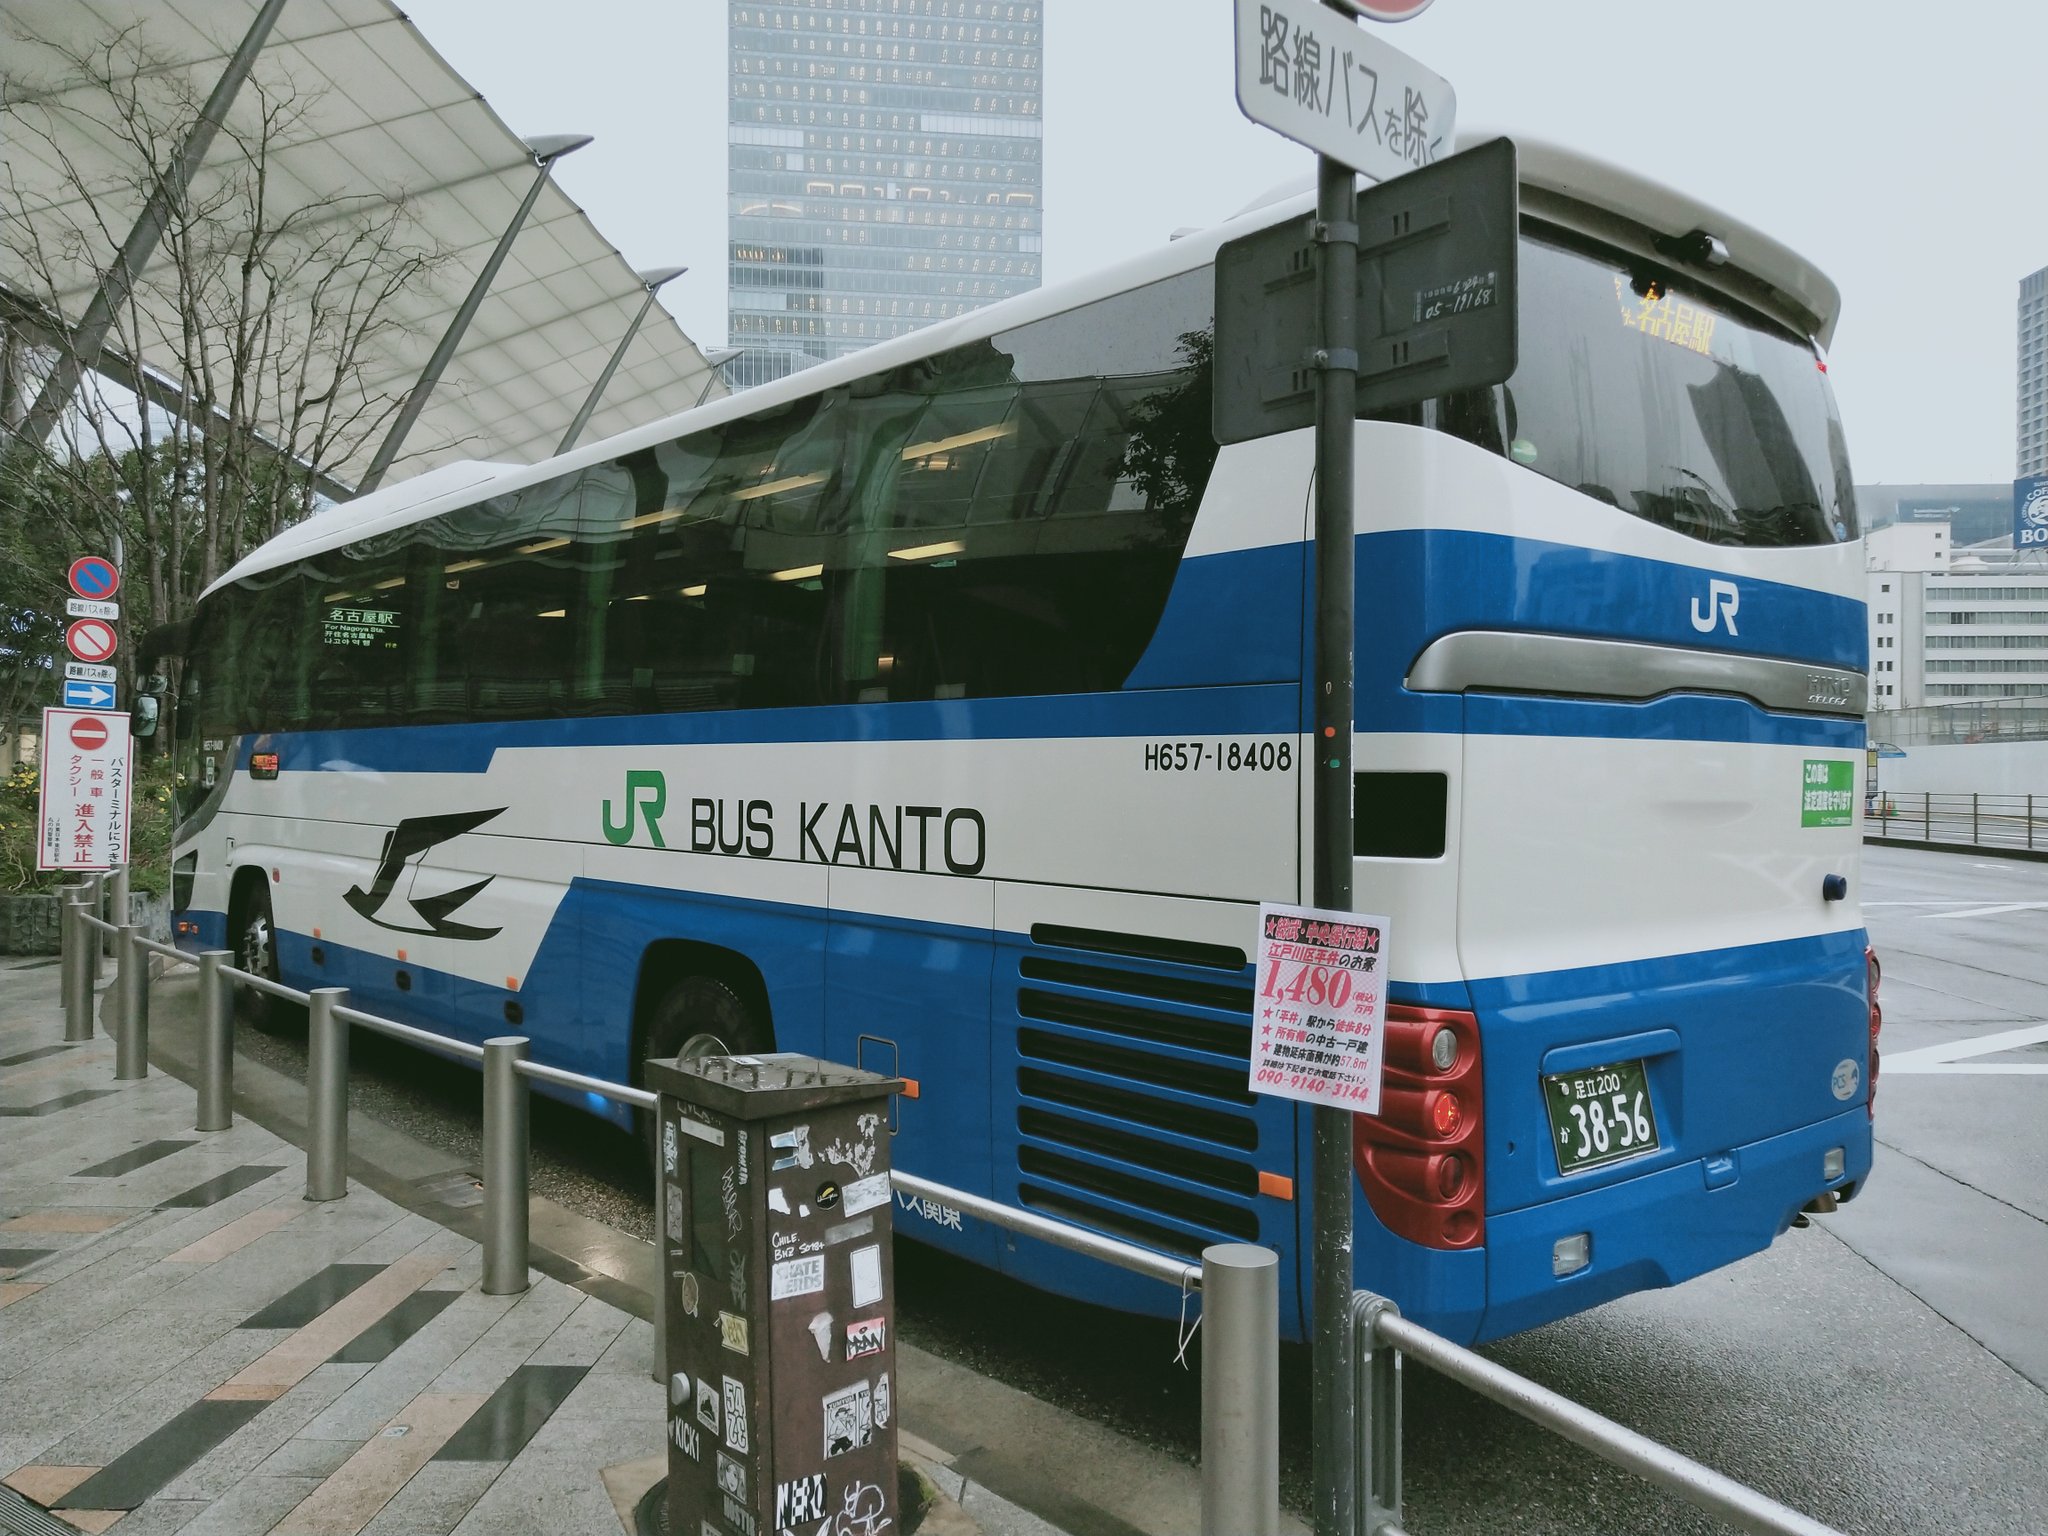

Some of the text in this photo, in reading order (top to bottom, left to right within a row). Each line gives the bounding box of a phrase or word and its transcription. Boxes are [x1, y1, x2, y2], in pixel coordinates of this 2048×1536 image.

[70, 603, 117, 616] 路線バスを除く
[329, 609, 393, 624] 名古屋駅
[1691, 578, 1739, 637] JR
[340, 624, 369, 632] Nagoya
[69, 665, 113, 679] 路線バスを除く
[1145, 742, 1292, 772] H657-18408
[69, 754, 83, 797] タクシー
[1805, 763, 1829, 785] この車は
[108, 756, 124, 863] バスターミナルにつき
[603, 770, 986, 876] JR BUS KANTO
[72, 803, 96, 864] 進入禁止
[1268, 942, 1377, 972] 江戸川区平井のお家
[1260, 959, 1352, 1009] 1,480
[1354, 1003, 1375, 1016] 万円
[1274, 1026, 1369, 1055] 所有権の中古一戸建
[1256, 1069, 1370, 1101] 090-9140-3144
[1559, 1126, 1571, 1144] か
[1568, 1090, 1651, 1158] 38-56
